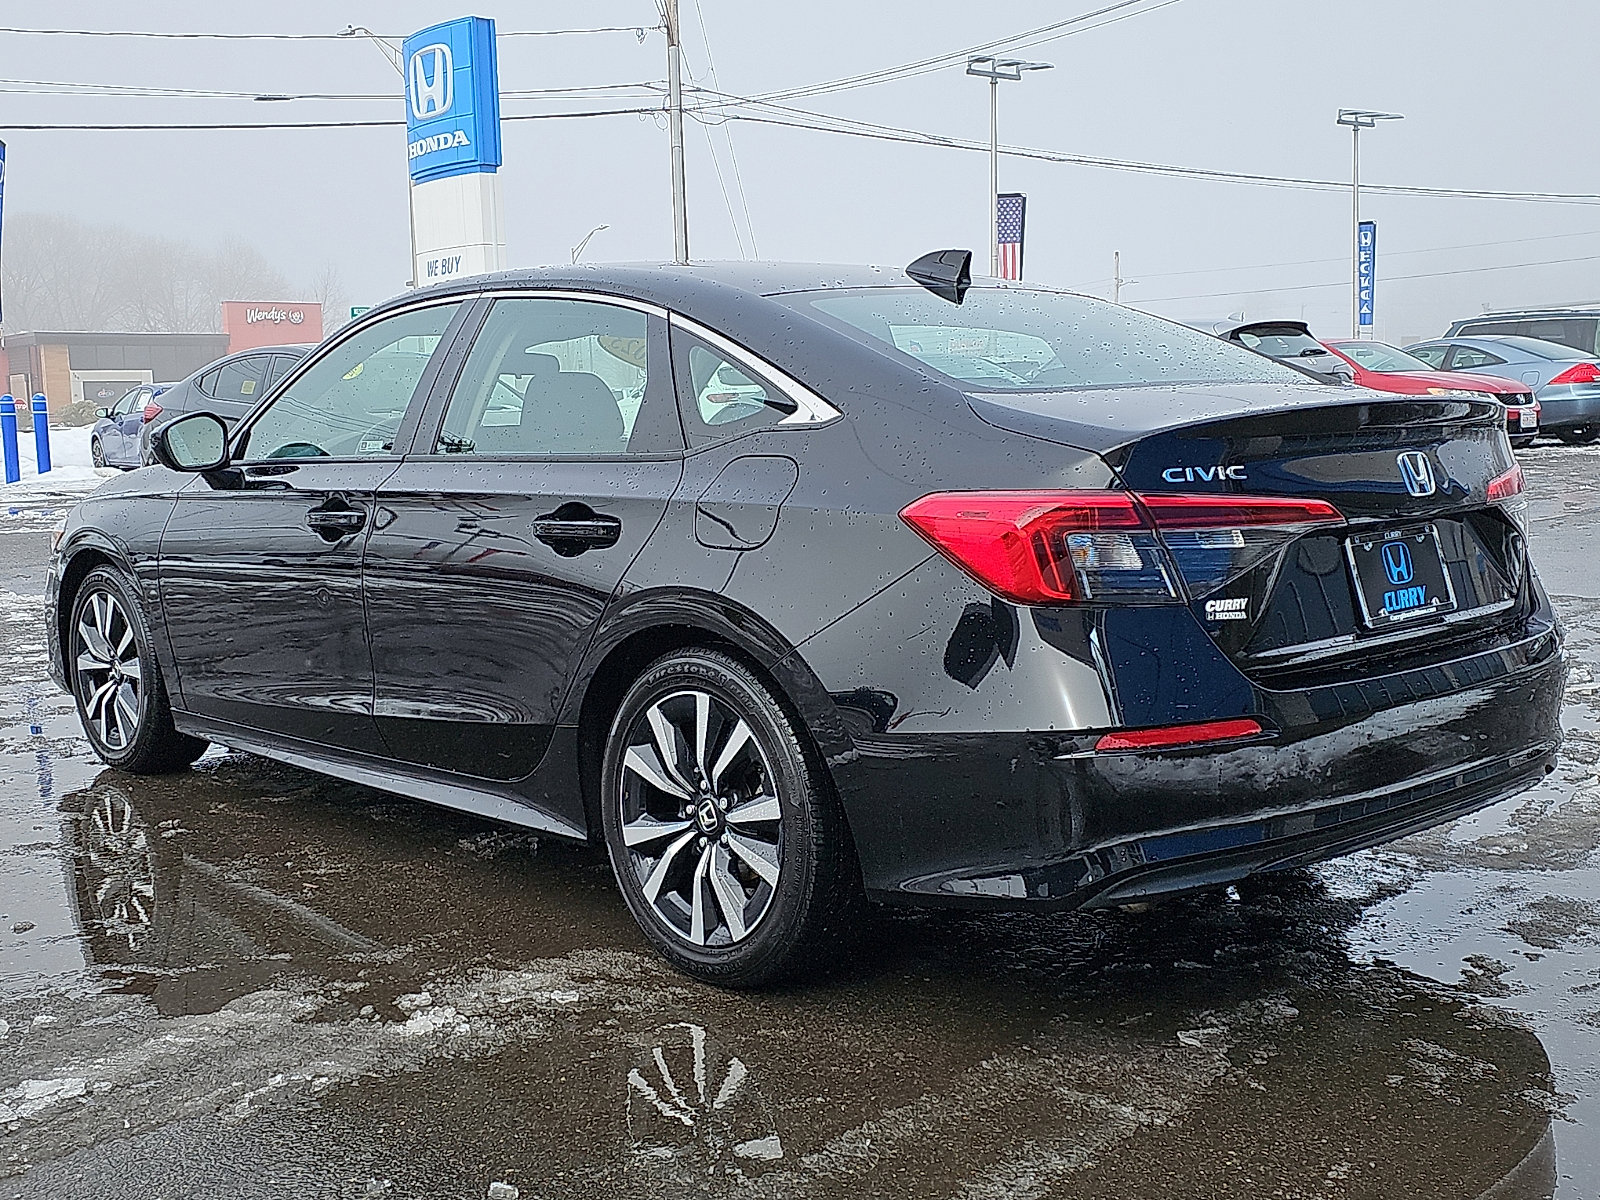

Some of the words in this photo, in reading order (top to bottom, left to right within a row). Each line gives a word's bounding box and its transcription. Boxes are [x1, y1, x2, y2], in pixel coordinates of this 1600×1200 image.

[408, 130, 471, 160] HONDA
[427, 259, 439, 278] WE
[441, 255, 462, 275] BUY
[246, 306, 287, 324] Wendy's
[1161, 465, 1248, 483] CIVIC
[1205, 597, 1249, 612] CURRY
[1383, 585, 1427, 612] CURRY
[1214, 611, 1248, 620] HONDA
